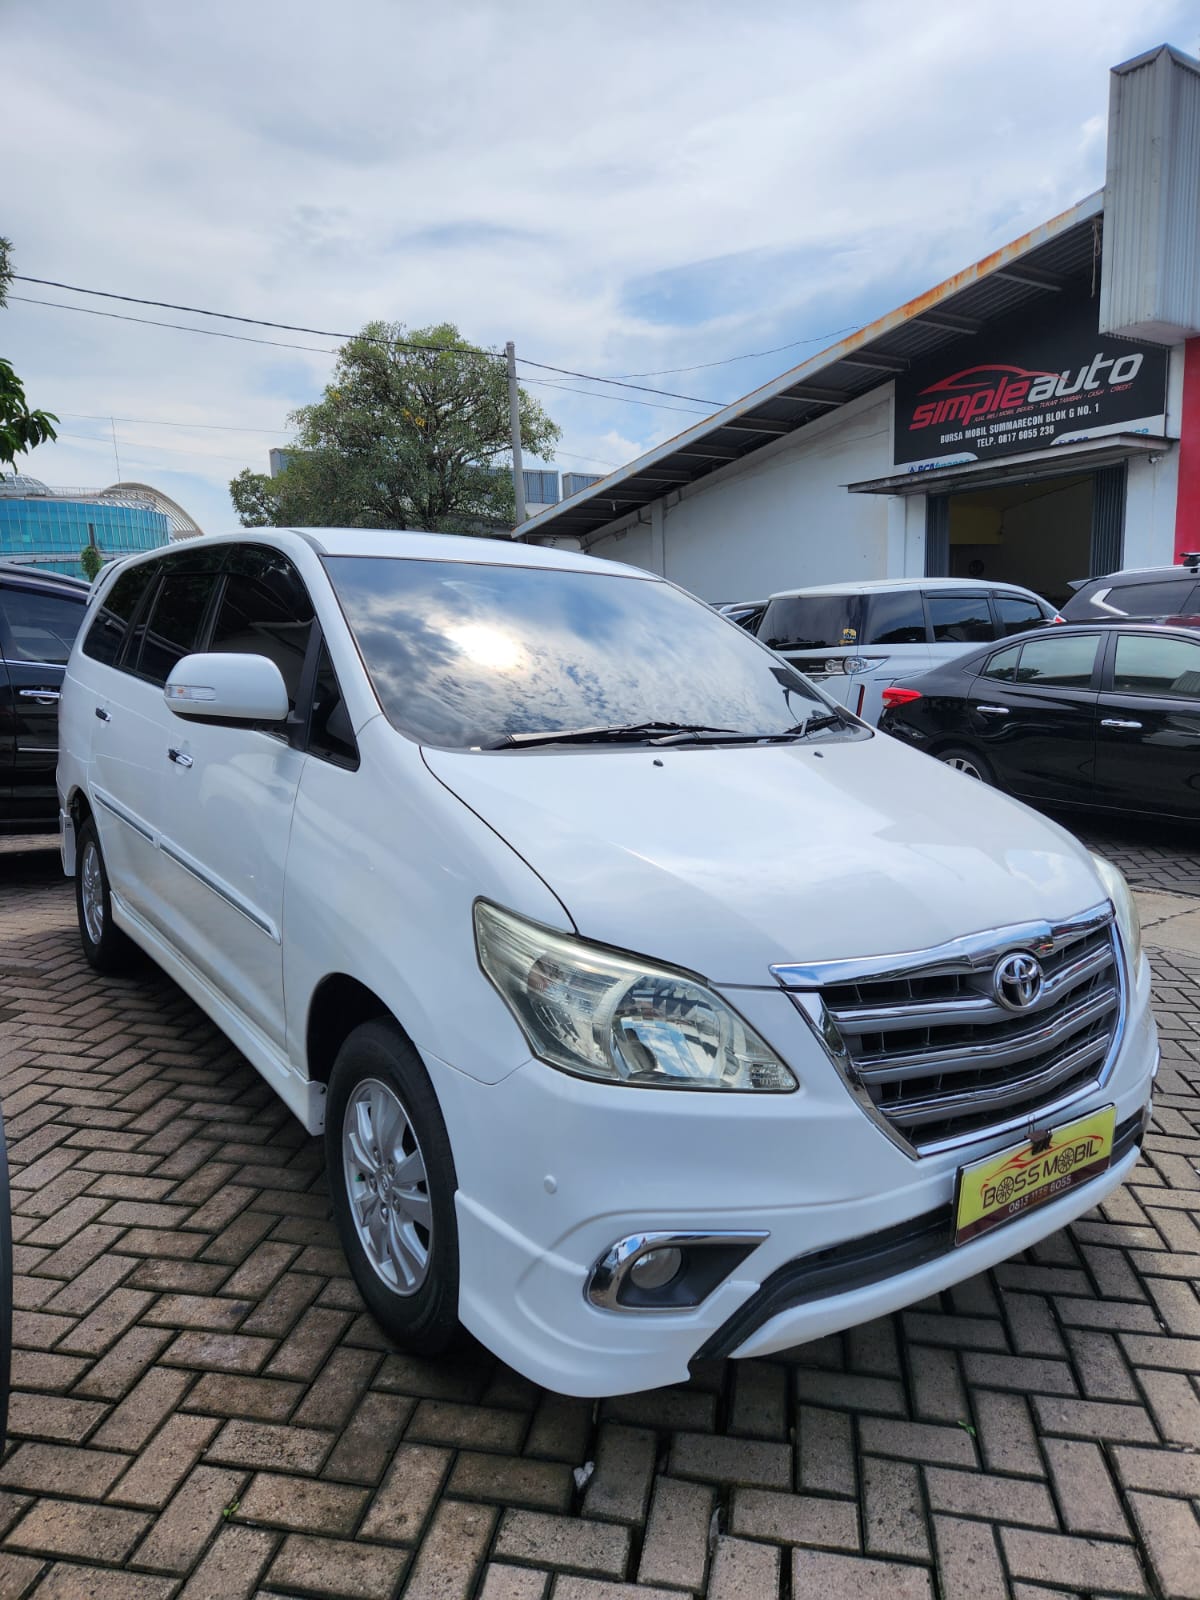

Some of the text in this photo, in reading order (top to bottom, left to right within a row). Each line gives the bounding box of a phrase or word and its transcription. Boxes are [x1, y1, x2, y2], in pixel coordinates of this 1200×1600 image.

[940, 430, 963, 444] BURSA
[965, 426, 988, 440] MOBIL
[989, 415, 1044, 434] SUMMARECON
[1045, 410, 1067, 423] BLOK
[1077, 405, 1092, 417] NO.
[1095, 403, 1100, 413] 1
[977, 436, 997, 448] TELP.
[998, 432, 1017, 444] 0817
[982, 1139, 1099, 1210] BOSS MOBIL
